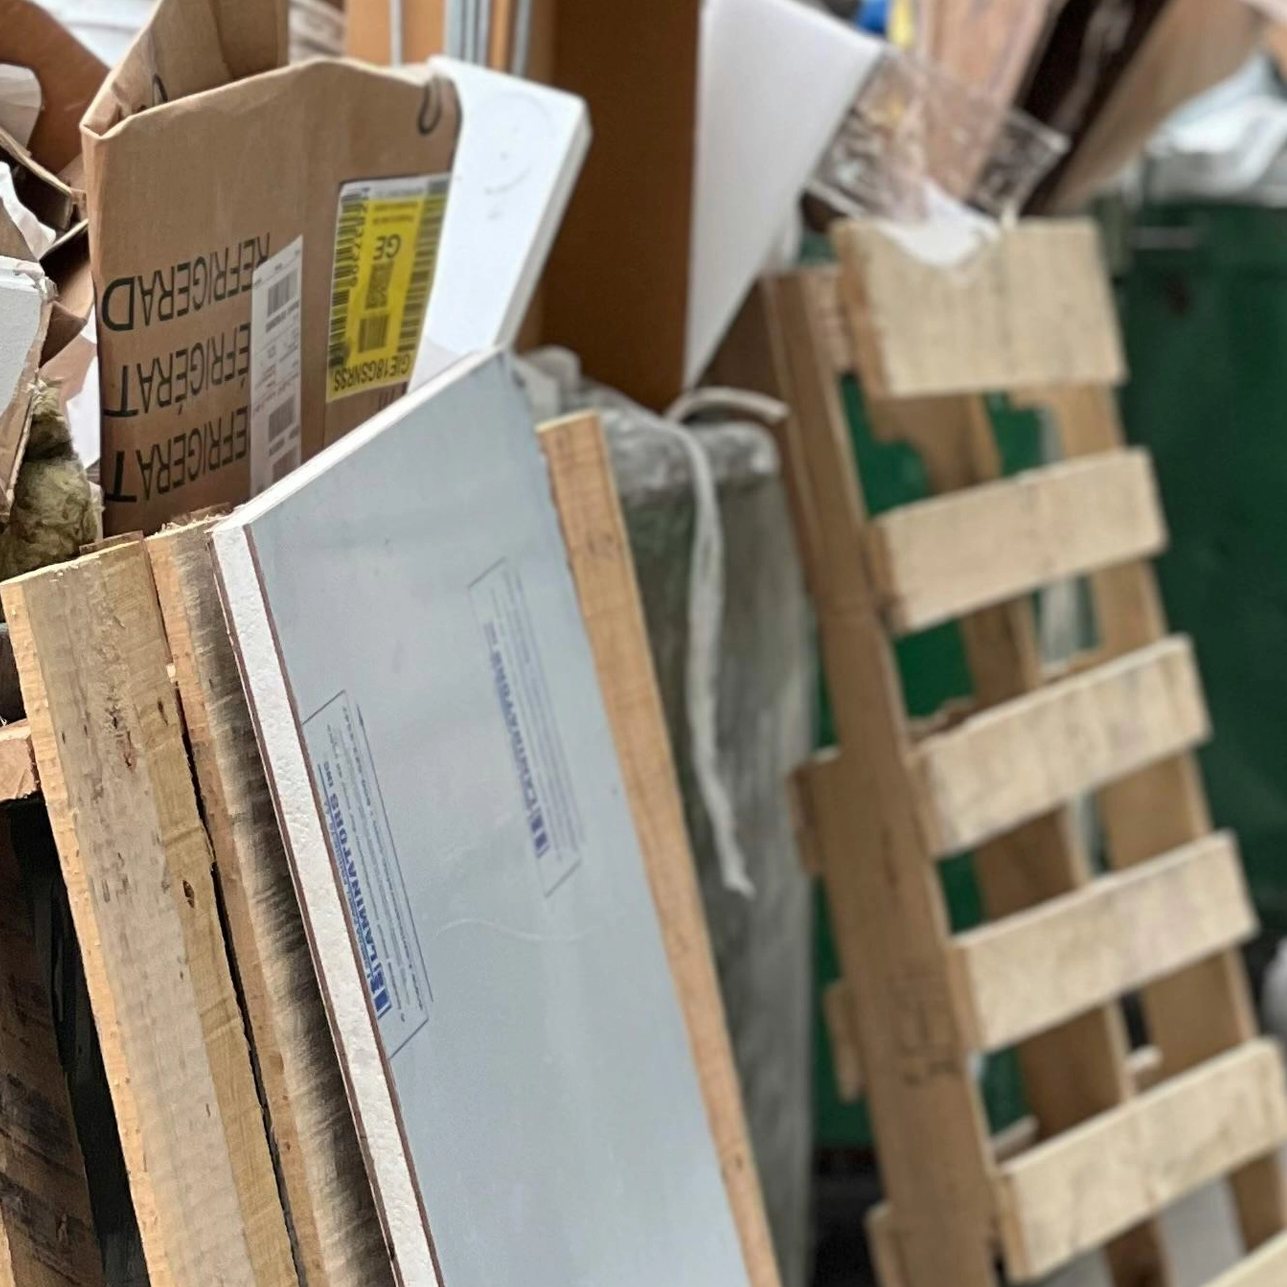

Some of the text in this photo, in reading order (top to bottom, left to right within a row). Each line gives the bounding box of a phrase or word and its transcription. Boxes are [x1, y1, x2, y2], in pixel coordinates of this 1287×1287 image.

[372, 234, 402, 261] GE
[103, 321, 251, 417] ÉFRIGÉRAT
[103, 404, 248, 503] EFRIGERAT
[329, 791, 377, 962] LAMINATORS
